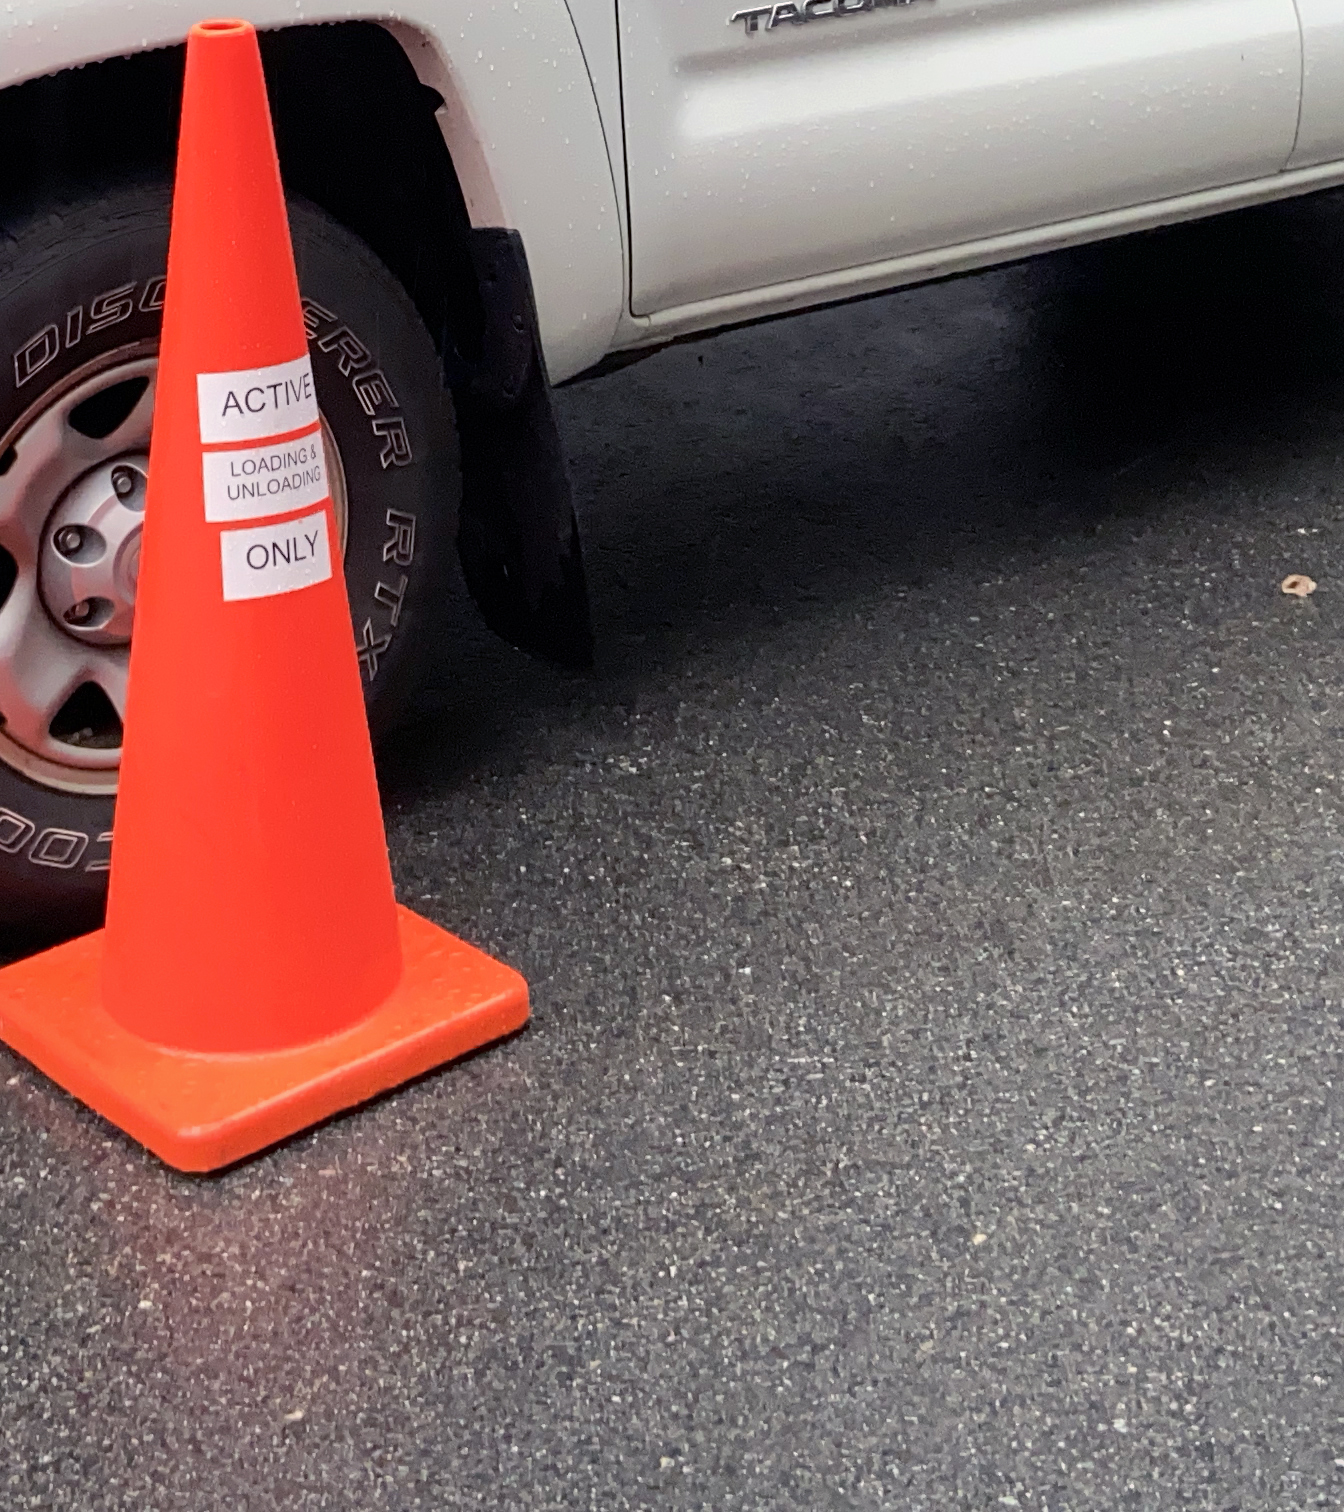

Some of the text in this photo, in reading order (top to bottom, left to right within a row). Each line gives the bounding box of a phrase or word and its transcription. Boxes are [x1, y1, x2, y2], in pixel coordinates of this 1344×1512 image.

[221, 372, 313, 418] ACTIVE
[230, 443, 318, 478] LOADING &
[226, 464, 322, 501] UNLOADING
[245, 529, 320, 571] ONLY
[358, 507, 418, 682] RTX
